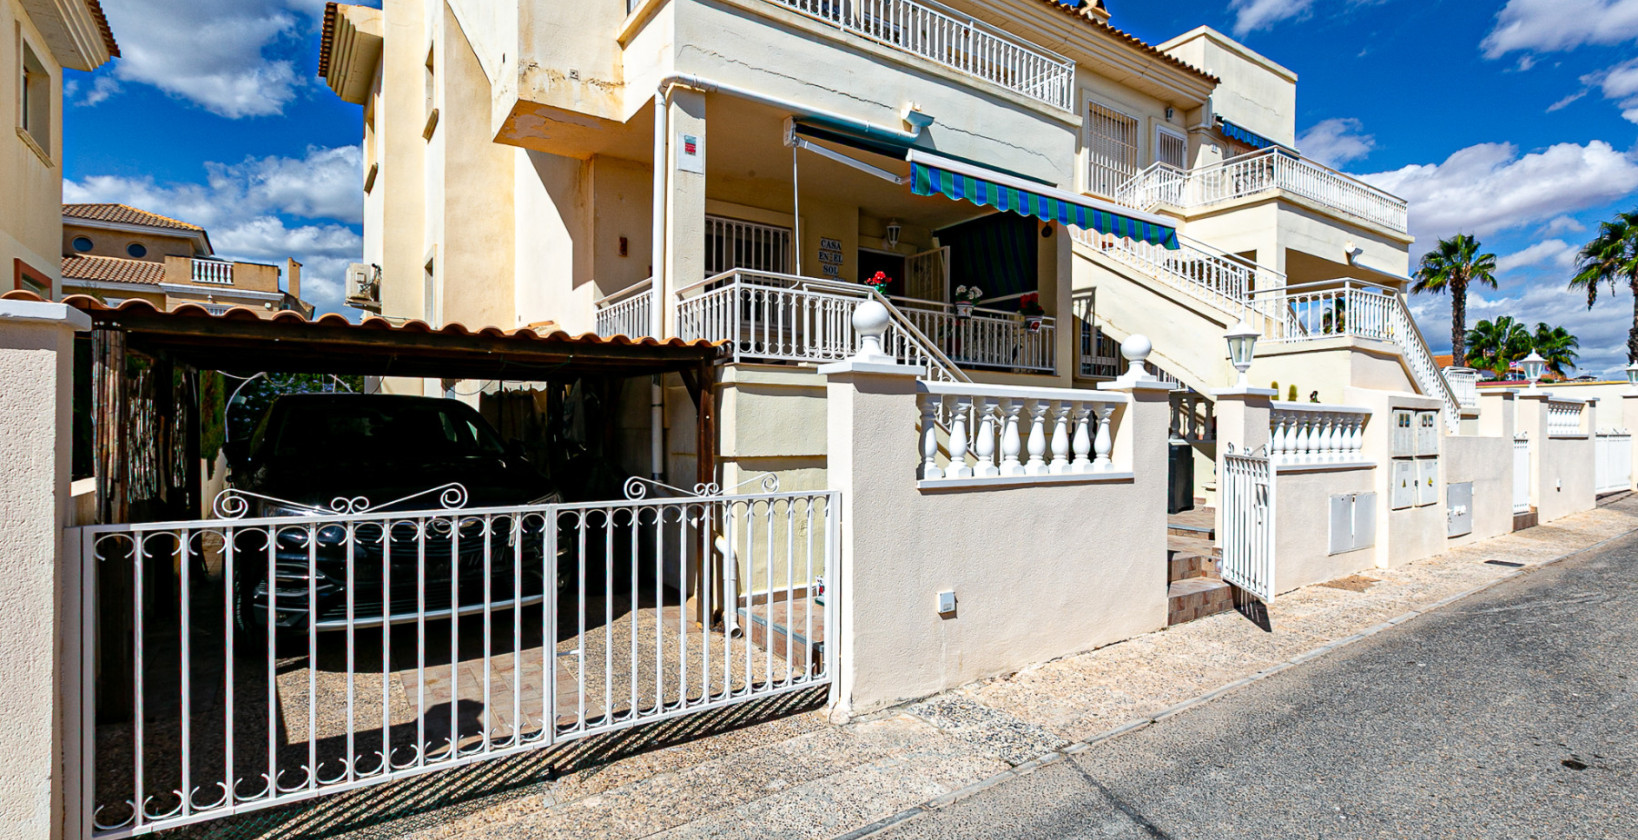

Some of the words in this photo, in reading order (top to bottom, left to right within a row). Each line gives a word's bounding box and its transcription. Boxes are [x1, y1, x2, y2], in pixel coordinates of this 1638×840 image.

[820, 239, 841, 250] CASA
[819, 251, 829, 260] EN
[833, 254, 842, 263] EL
[823, 265, 838, 275] SOL
